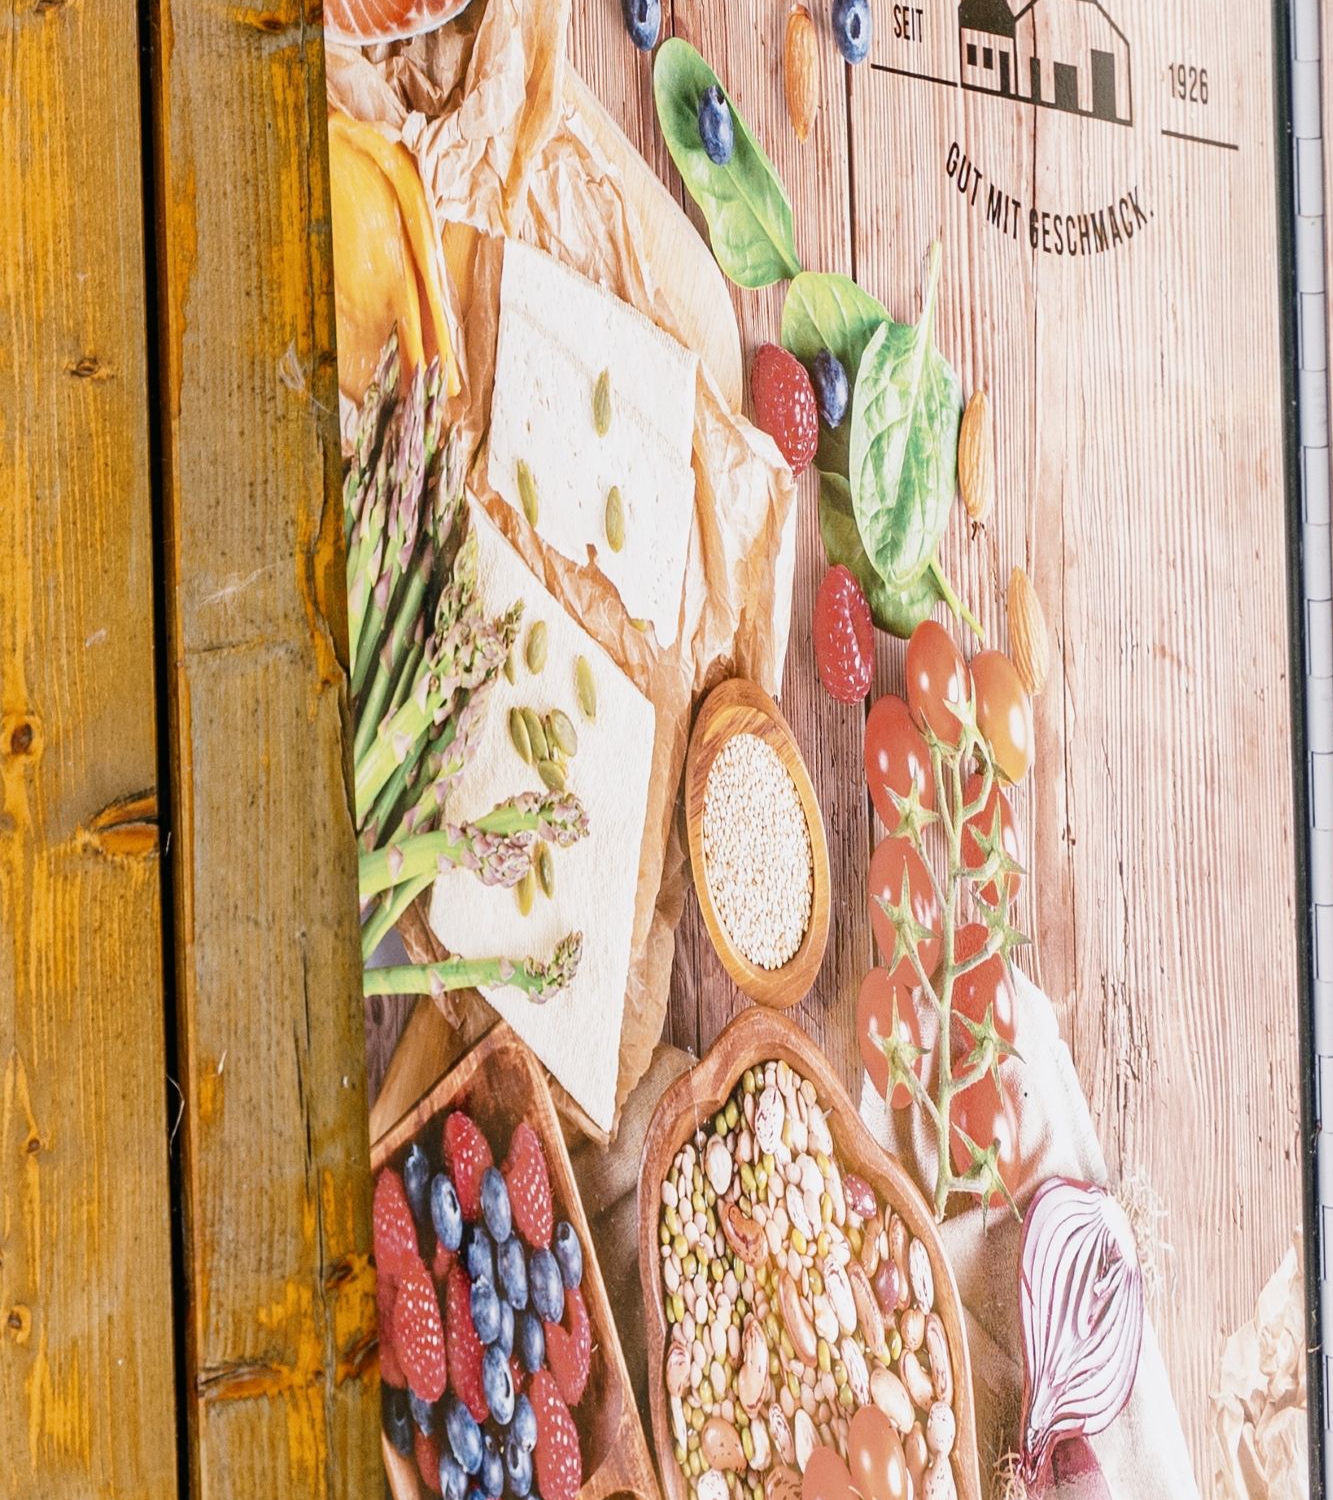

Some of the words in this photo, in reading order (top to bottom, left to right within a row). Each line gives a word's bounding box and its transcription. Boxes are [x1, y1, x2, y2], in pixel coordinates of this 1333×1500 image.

[892, 3, 924, 44] SEIT
[1167, 62, 1208, 105] 1926
[945, 141, 982, 194] GUT
[987, 190, 1021, 242] MIT
[1029, 183, 1155, 256] GESCHMACK.
